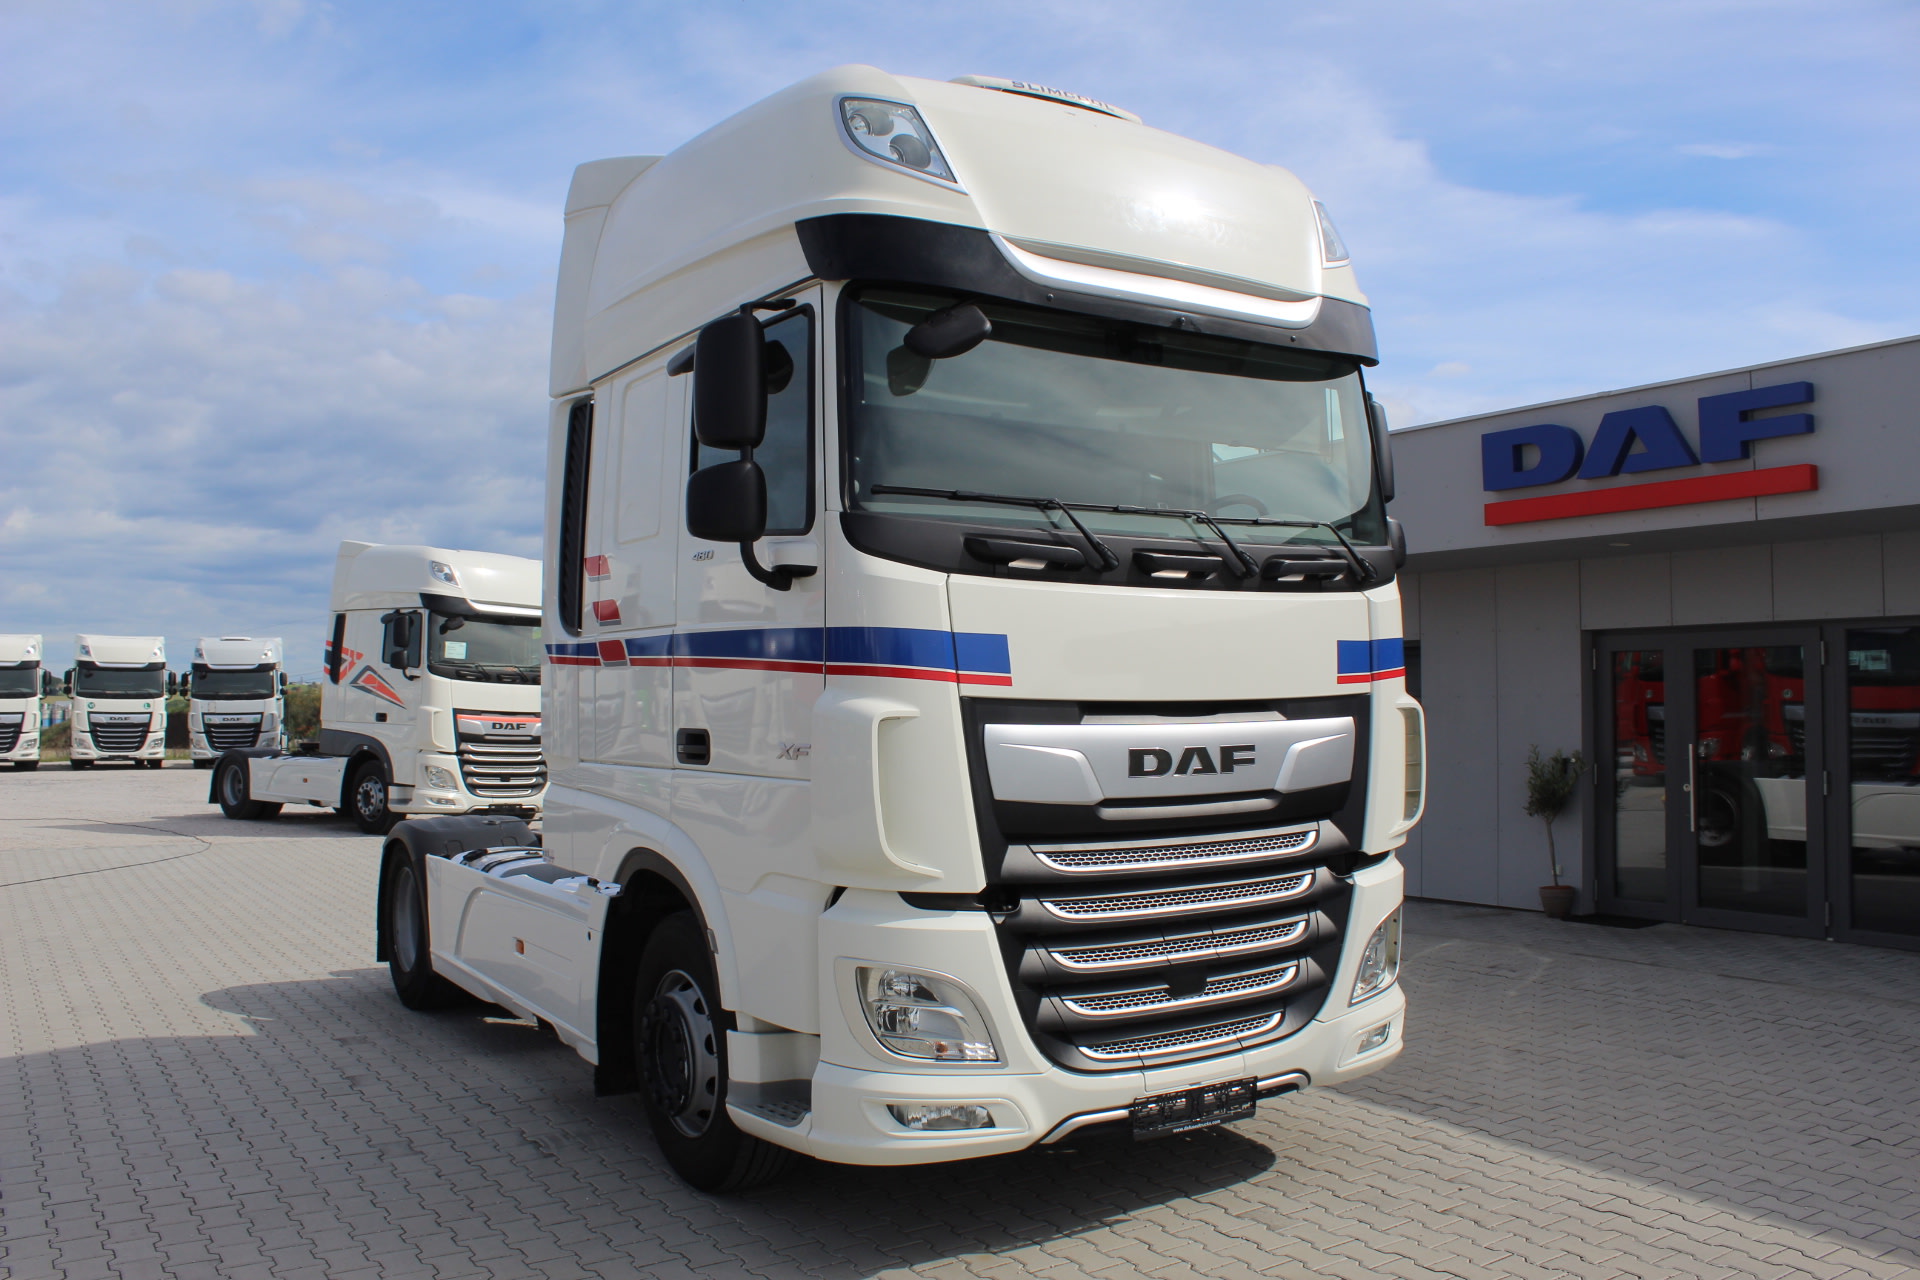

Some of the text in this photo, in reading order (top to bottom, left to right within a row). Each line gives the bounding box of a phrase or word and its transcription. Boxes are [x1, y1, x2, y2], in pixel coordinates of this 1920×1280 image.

[1481, 381, 1815, 492] DAF
[491, 722, 527, 730] DAF
[776, 742, 812, 760] XF
[1128, 744, 1256, 778] DAF
